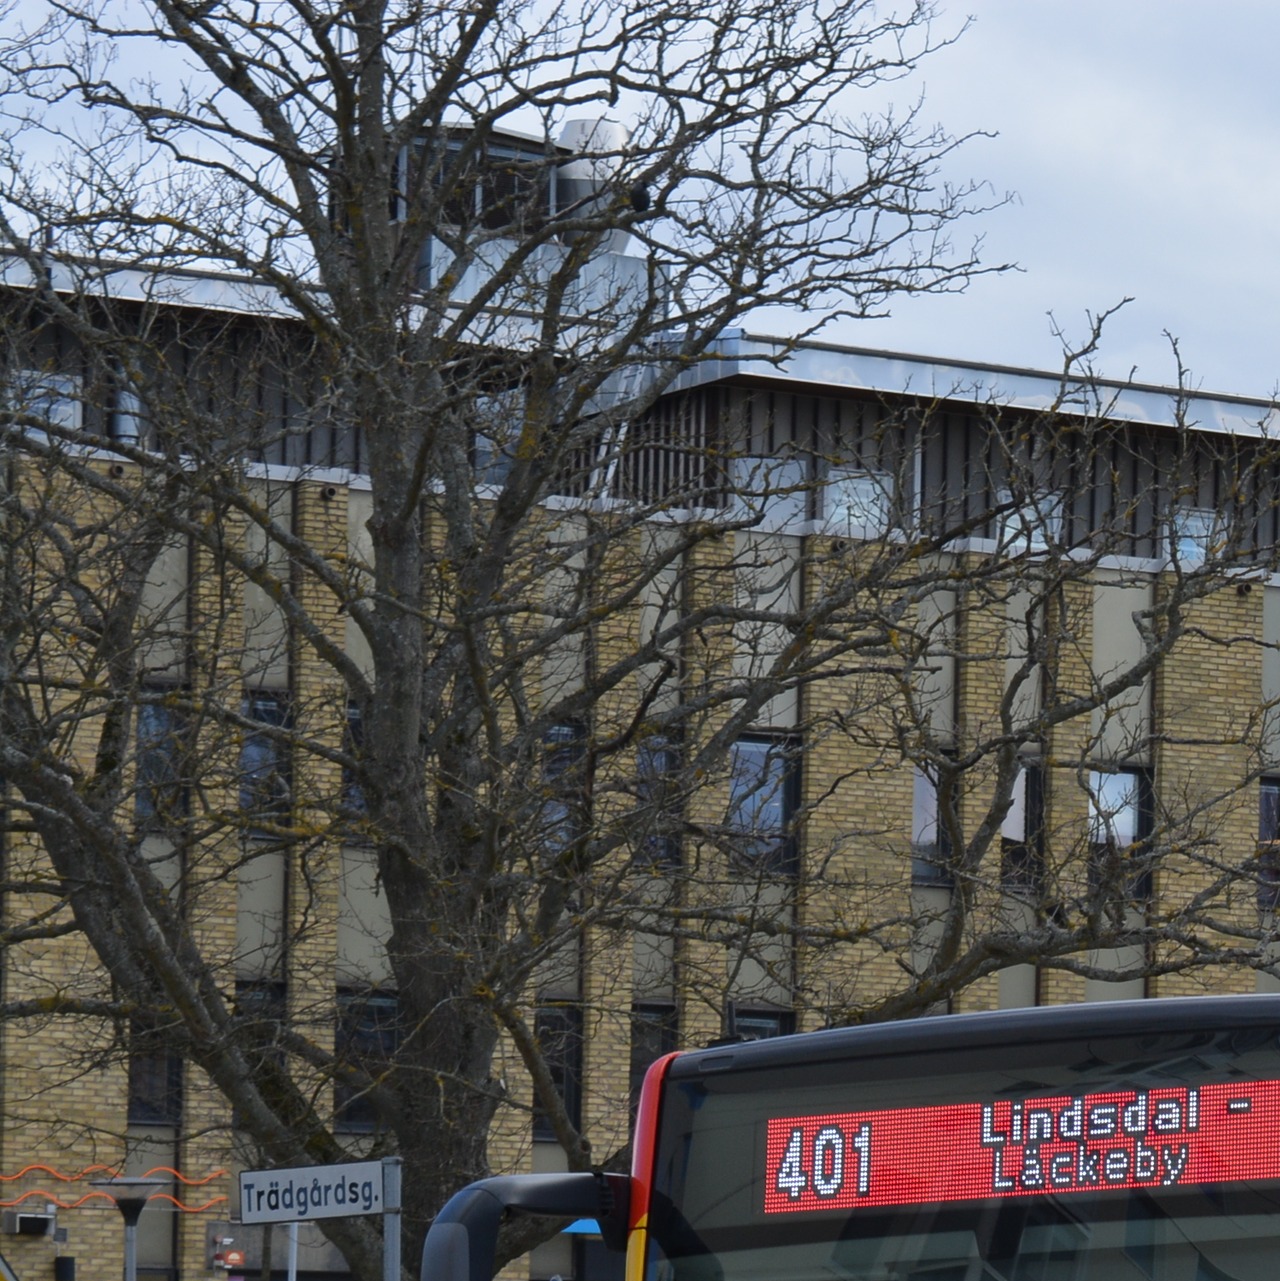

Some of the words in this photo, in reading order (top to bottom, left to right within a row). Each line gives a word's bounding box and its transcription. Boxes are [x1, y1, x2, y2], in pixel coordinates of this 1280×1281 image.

[982, 1090, 1198, 1143] Lindsdal
[778, 1125, 870, 1198] 401
[994, 1140, 1187, 1188] Läckeby
[243, 1175, 379, 1216] Trädgårdsg.
